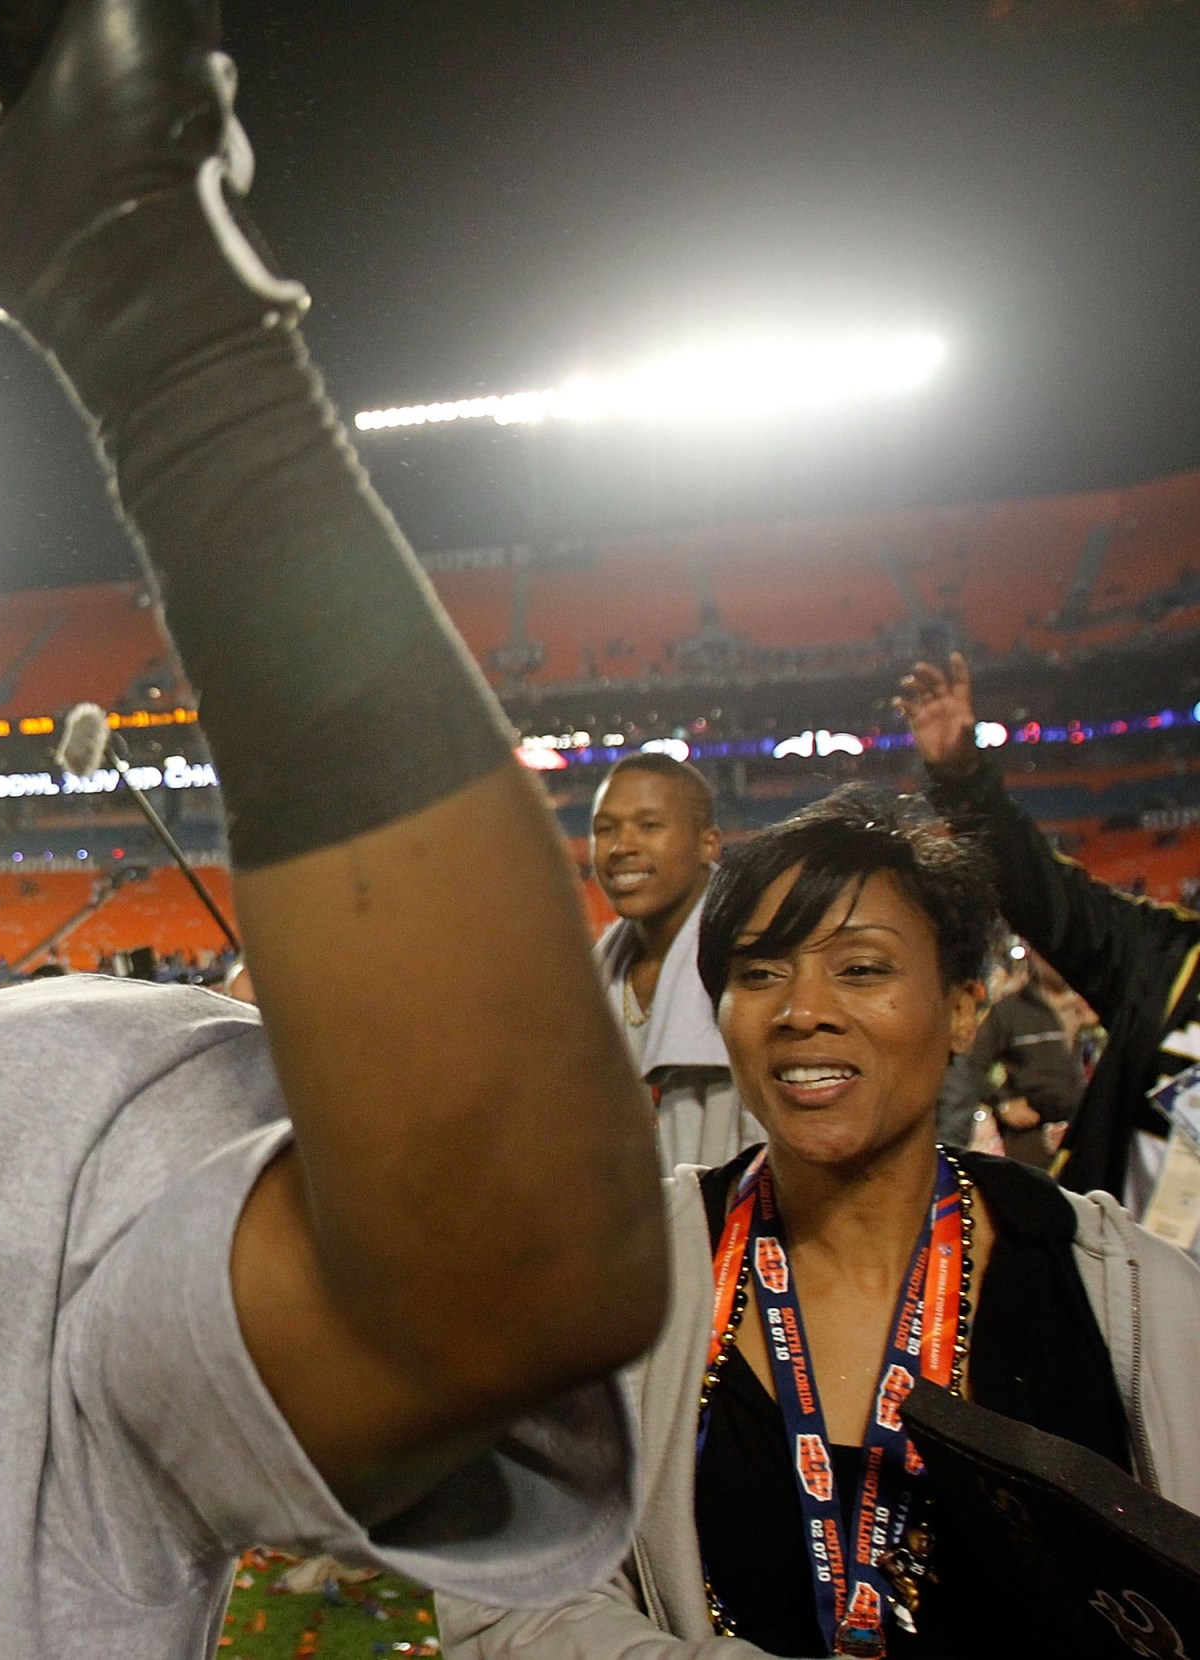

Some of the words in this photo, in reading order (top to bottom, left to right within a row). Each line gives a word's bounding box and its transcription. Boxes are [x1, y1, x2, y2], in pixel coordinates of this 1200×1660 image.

[895, 1301, 915, 1350] SOUTH
[780, 1306, 803, 1354] SOUTH
[792, 1355, 816, 1415] FLORIDA
[862, 1446, 884, 1508] FLORIDA
[823, 1519, 845, 1575] SOUTH
[856, 1507, 876, 1565] SOUTH
